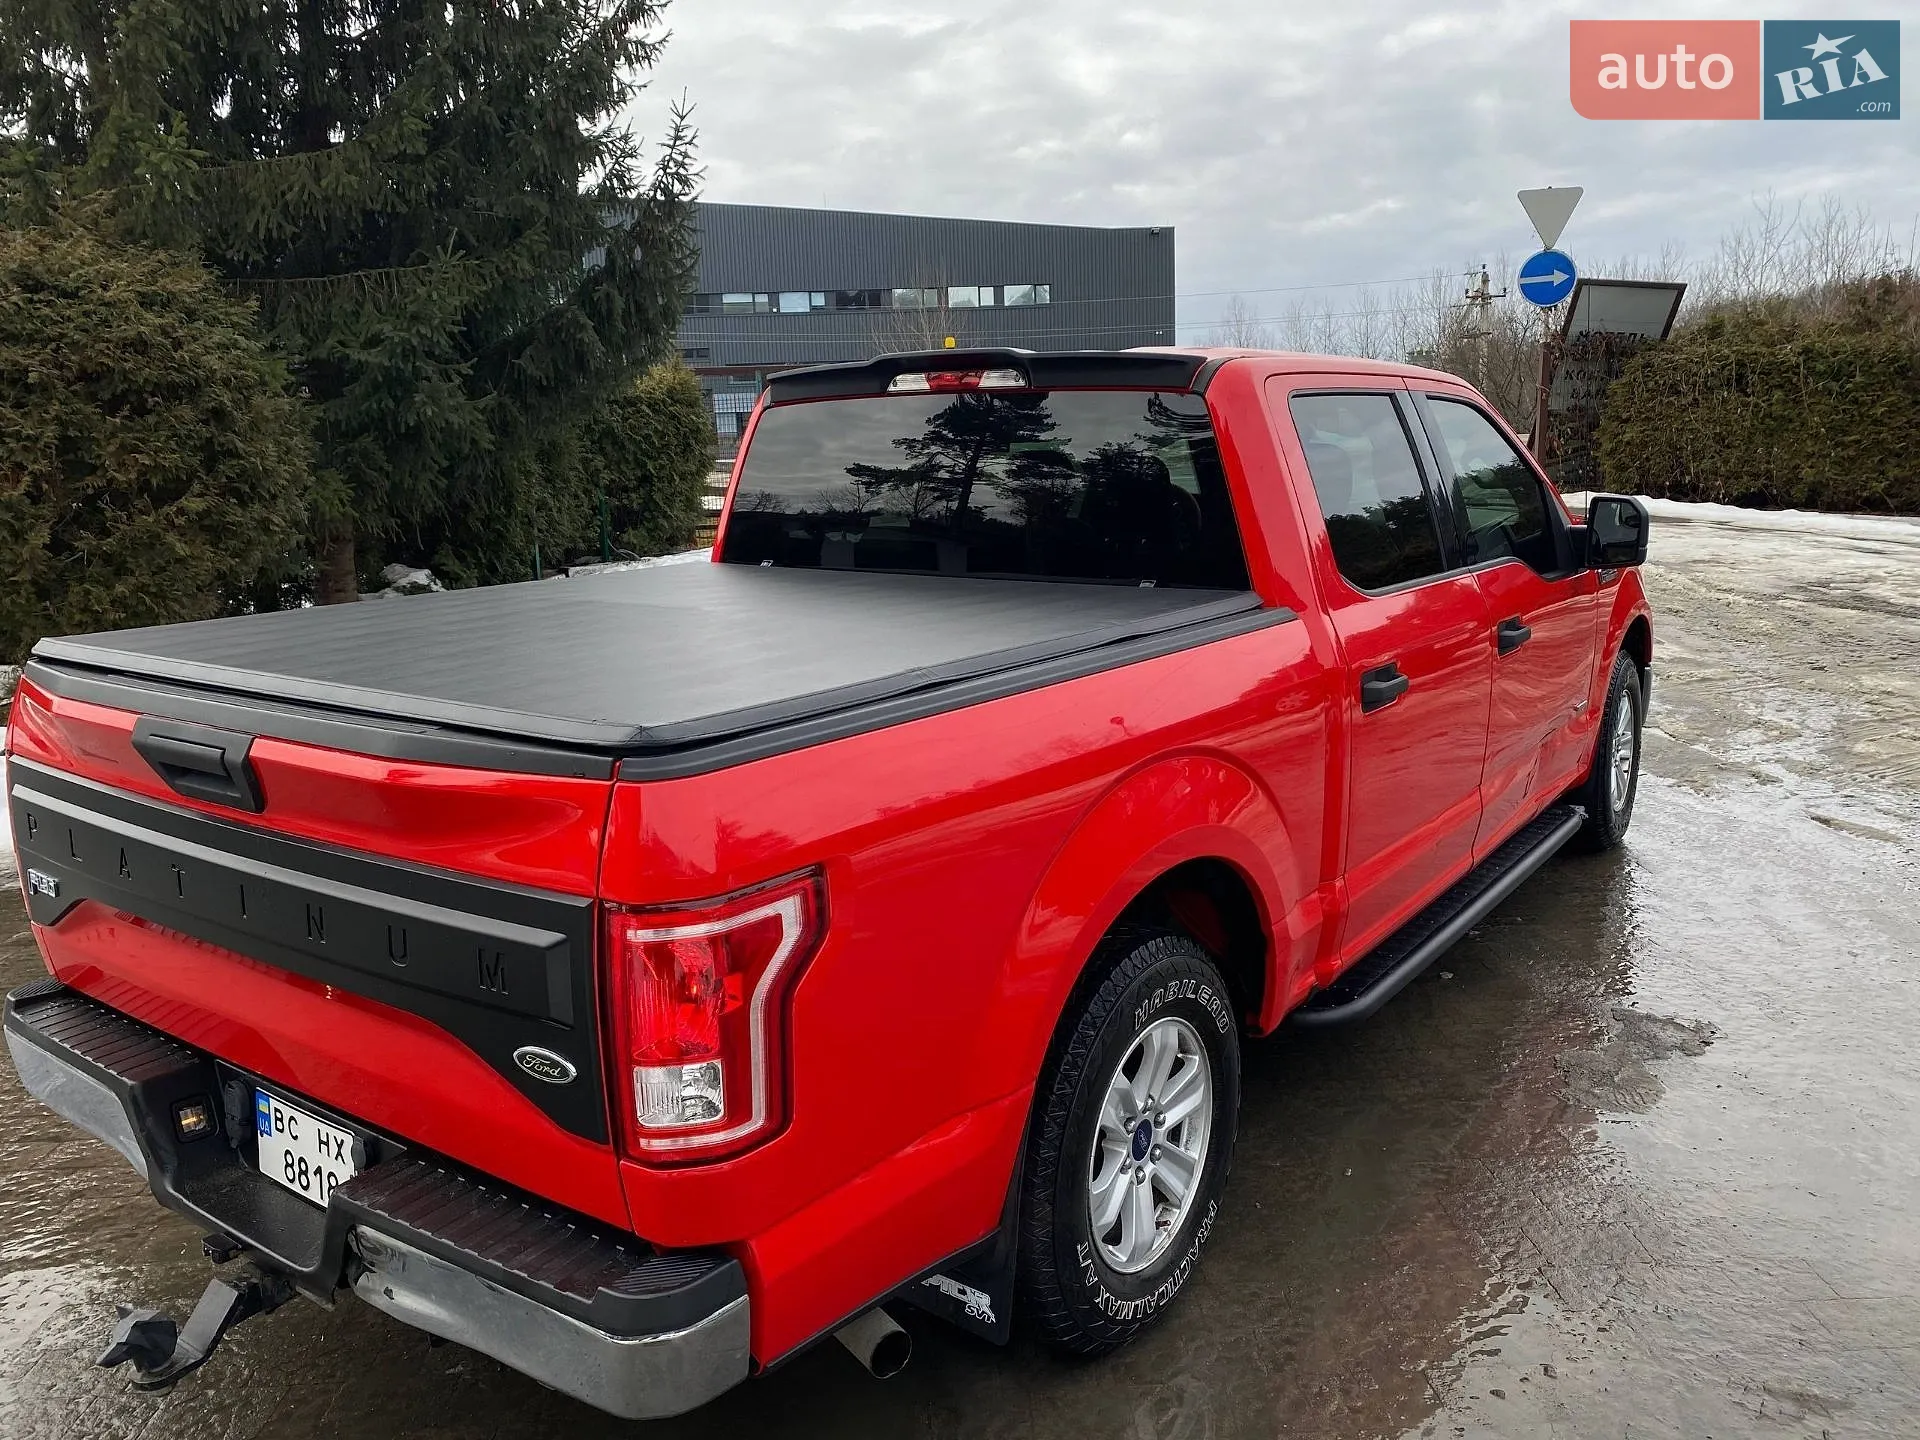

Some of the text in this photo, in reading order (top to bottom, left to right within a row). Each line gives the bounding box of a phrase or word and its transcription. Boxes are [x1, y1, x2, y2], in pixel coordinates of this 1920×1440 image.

[26, 812, 509, 996] PLATINUM
[1135, 979, 1230, 1034] HABILEAD
[523, 1054, 562, 1077] Ford
[259, 1117, 271, 1135] UA
[273, 1106, 346, 1165] BC HX
[1094, 1199, 1218, 1320] PRACTICALMAX
